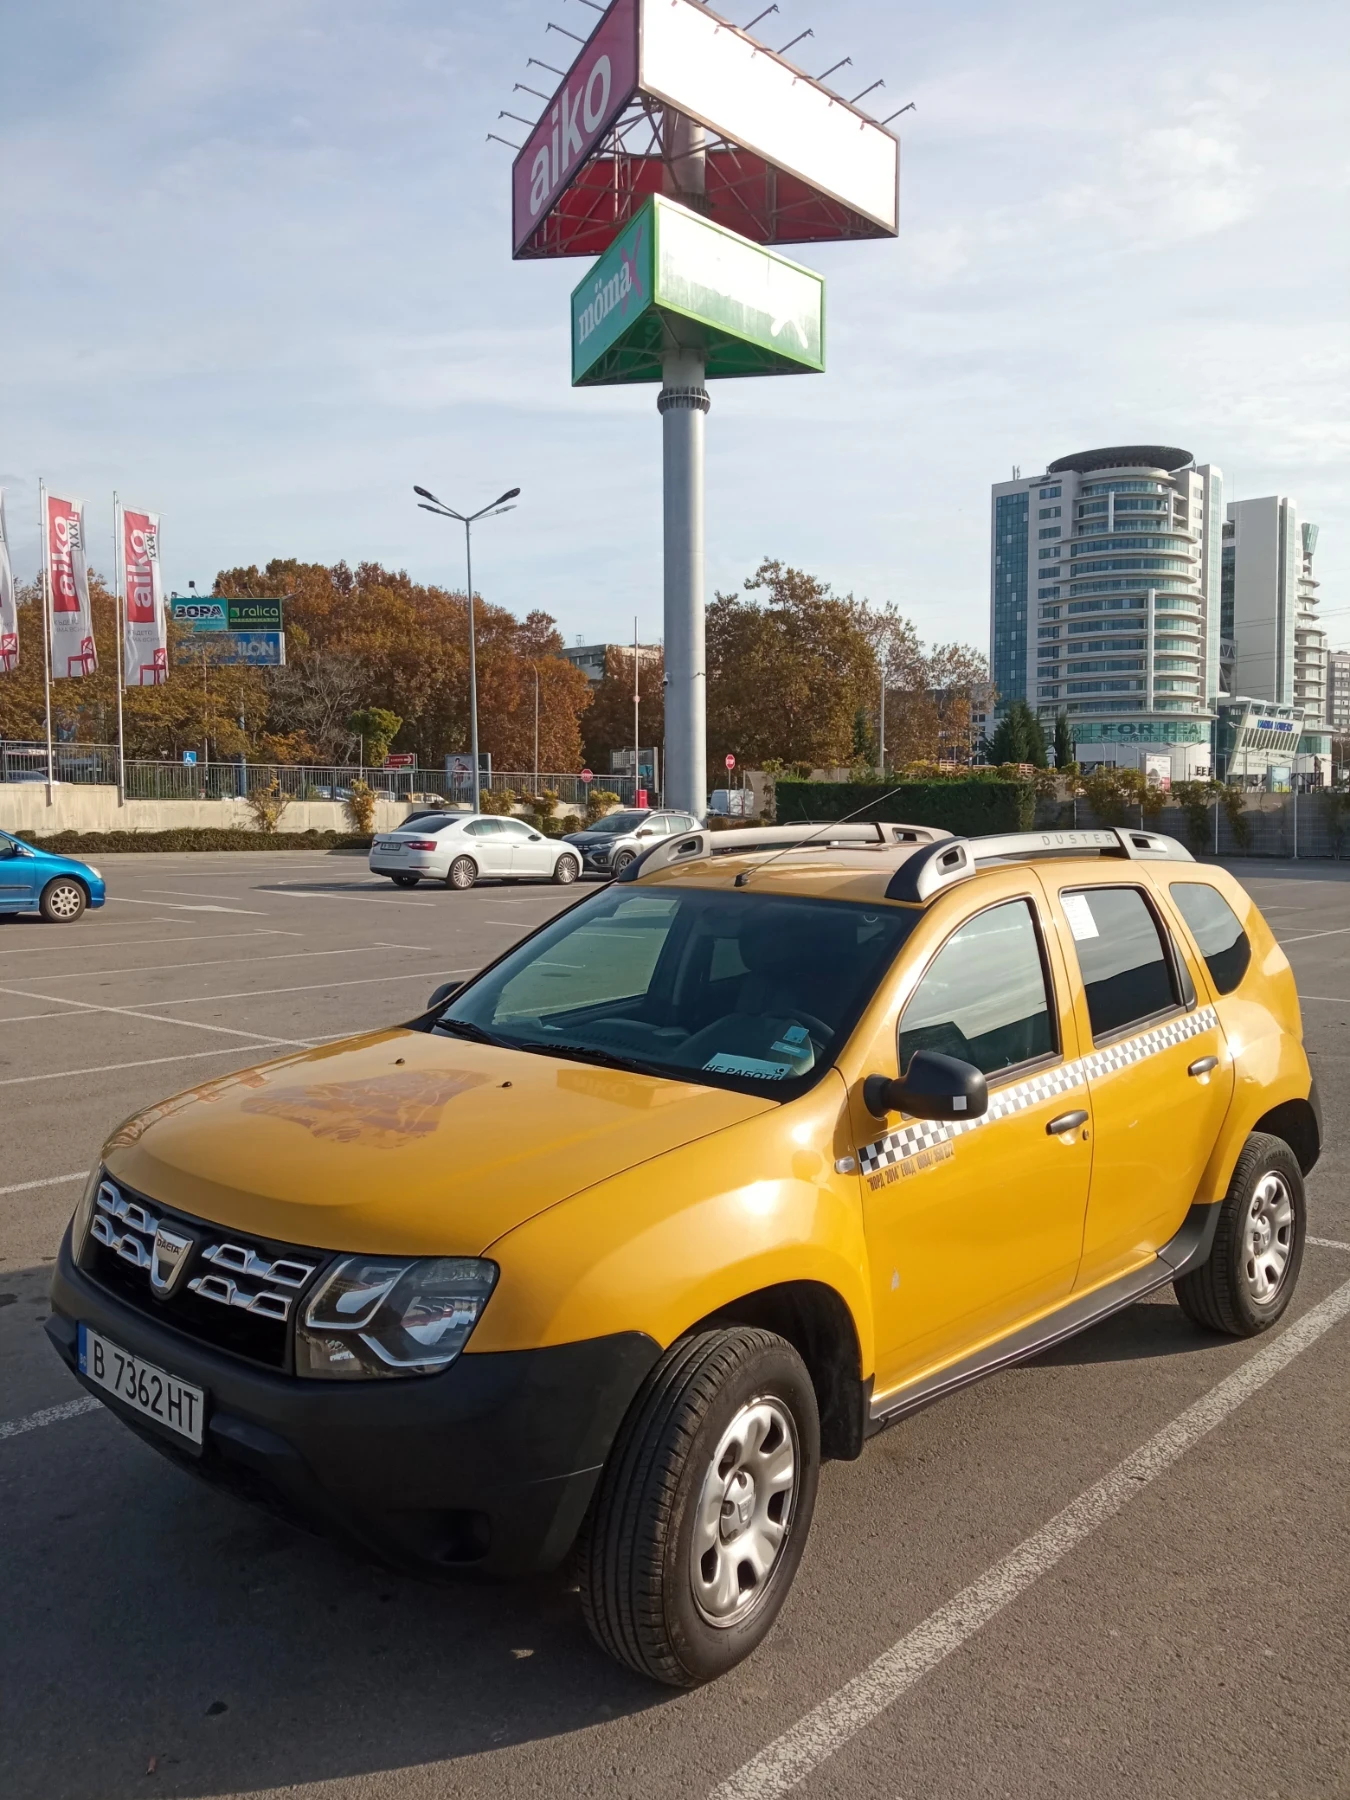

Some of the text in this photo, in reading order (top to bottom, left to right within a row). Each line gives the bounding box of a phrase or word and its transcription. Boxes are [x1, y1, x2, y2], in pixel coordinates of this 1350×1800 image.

[530, 55, 611, 215] aiko
[51, 515, 76, 597] aiko
[127, 529, 151, 608] aiko
[242, 605, 279, 617] ralica
[1102, 723, 1155, 735] FOR
[1041, 834, 1115, 846] DUSTER
